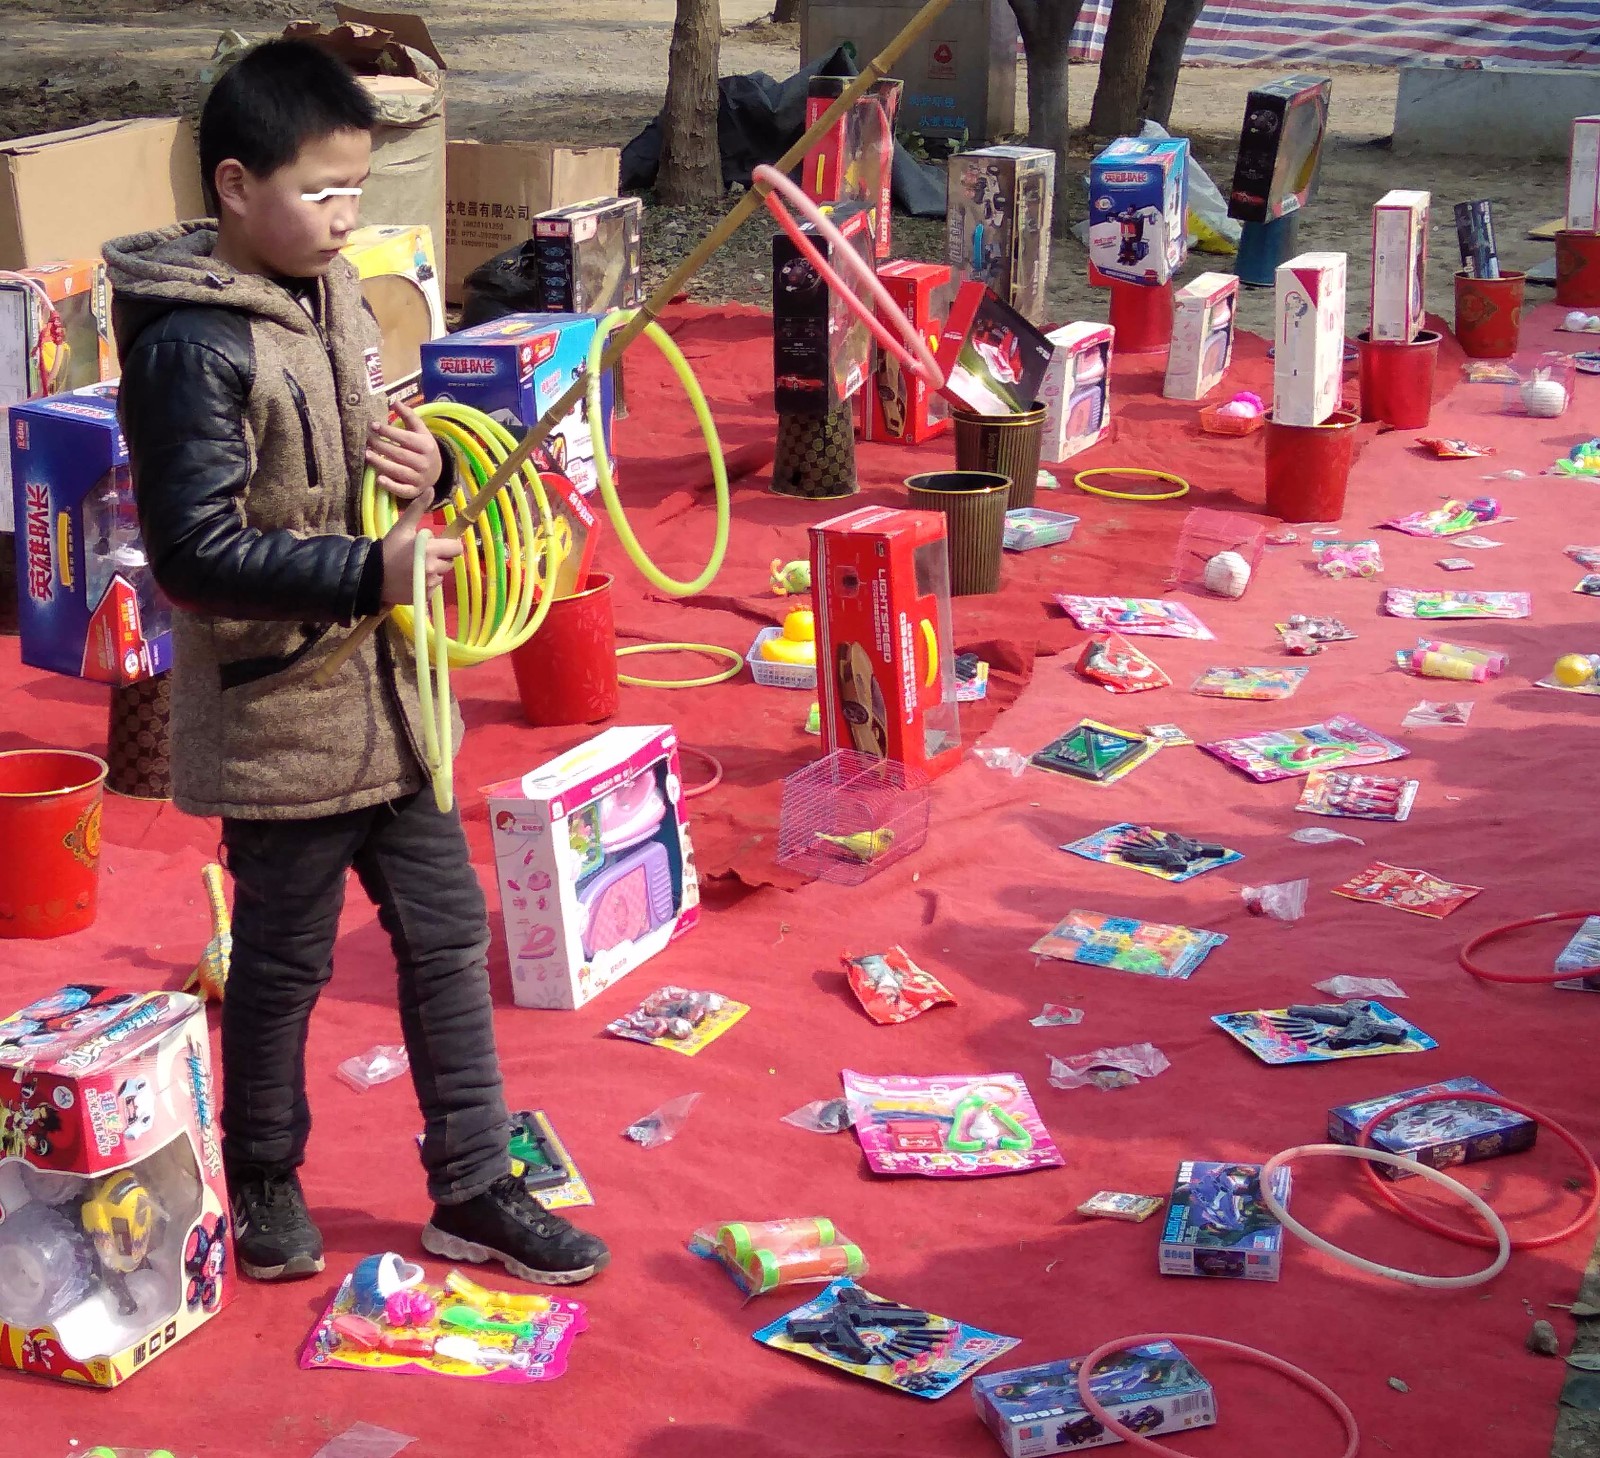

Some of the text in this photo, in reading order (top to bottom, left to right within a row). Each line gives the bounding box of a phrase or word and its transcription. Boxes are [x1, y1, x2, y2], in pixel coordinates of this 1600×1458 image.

[439, 357, 496, 374] 英雄队长
[27, 484, 53, 602] 英雄队长
[878, 568, 892, 663] LIGHTSPEED
